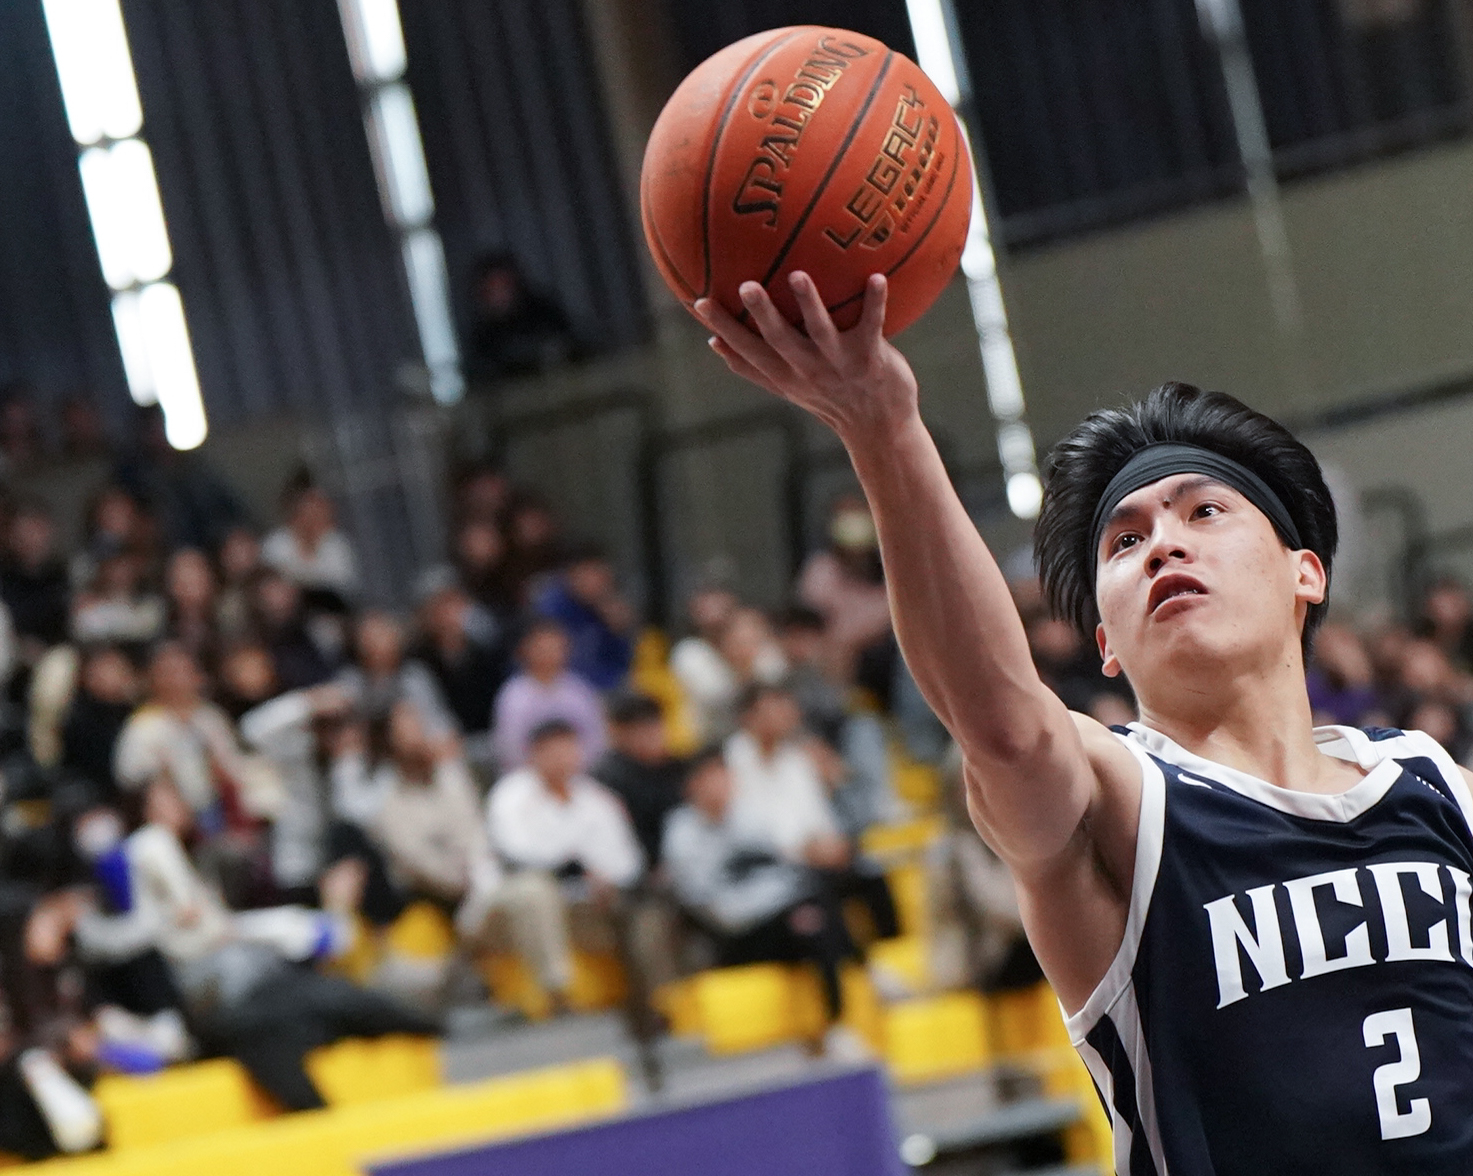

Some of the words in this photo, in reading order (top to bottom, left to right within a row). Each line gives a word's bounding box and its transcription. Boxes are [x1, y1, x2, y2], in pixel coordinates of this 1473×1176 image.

[733, 36, 872, 227] SPALDING
[824, 83, 925, 250] LEGACY
[1362, 1007, 1432, 1140] 2
